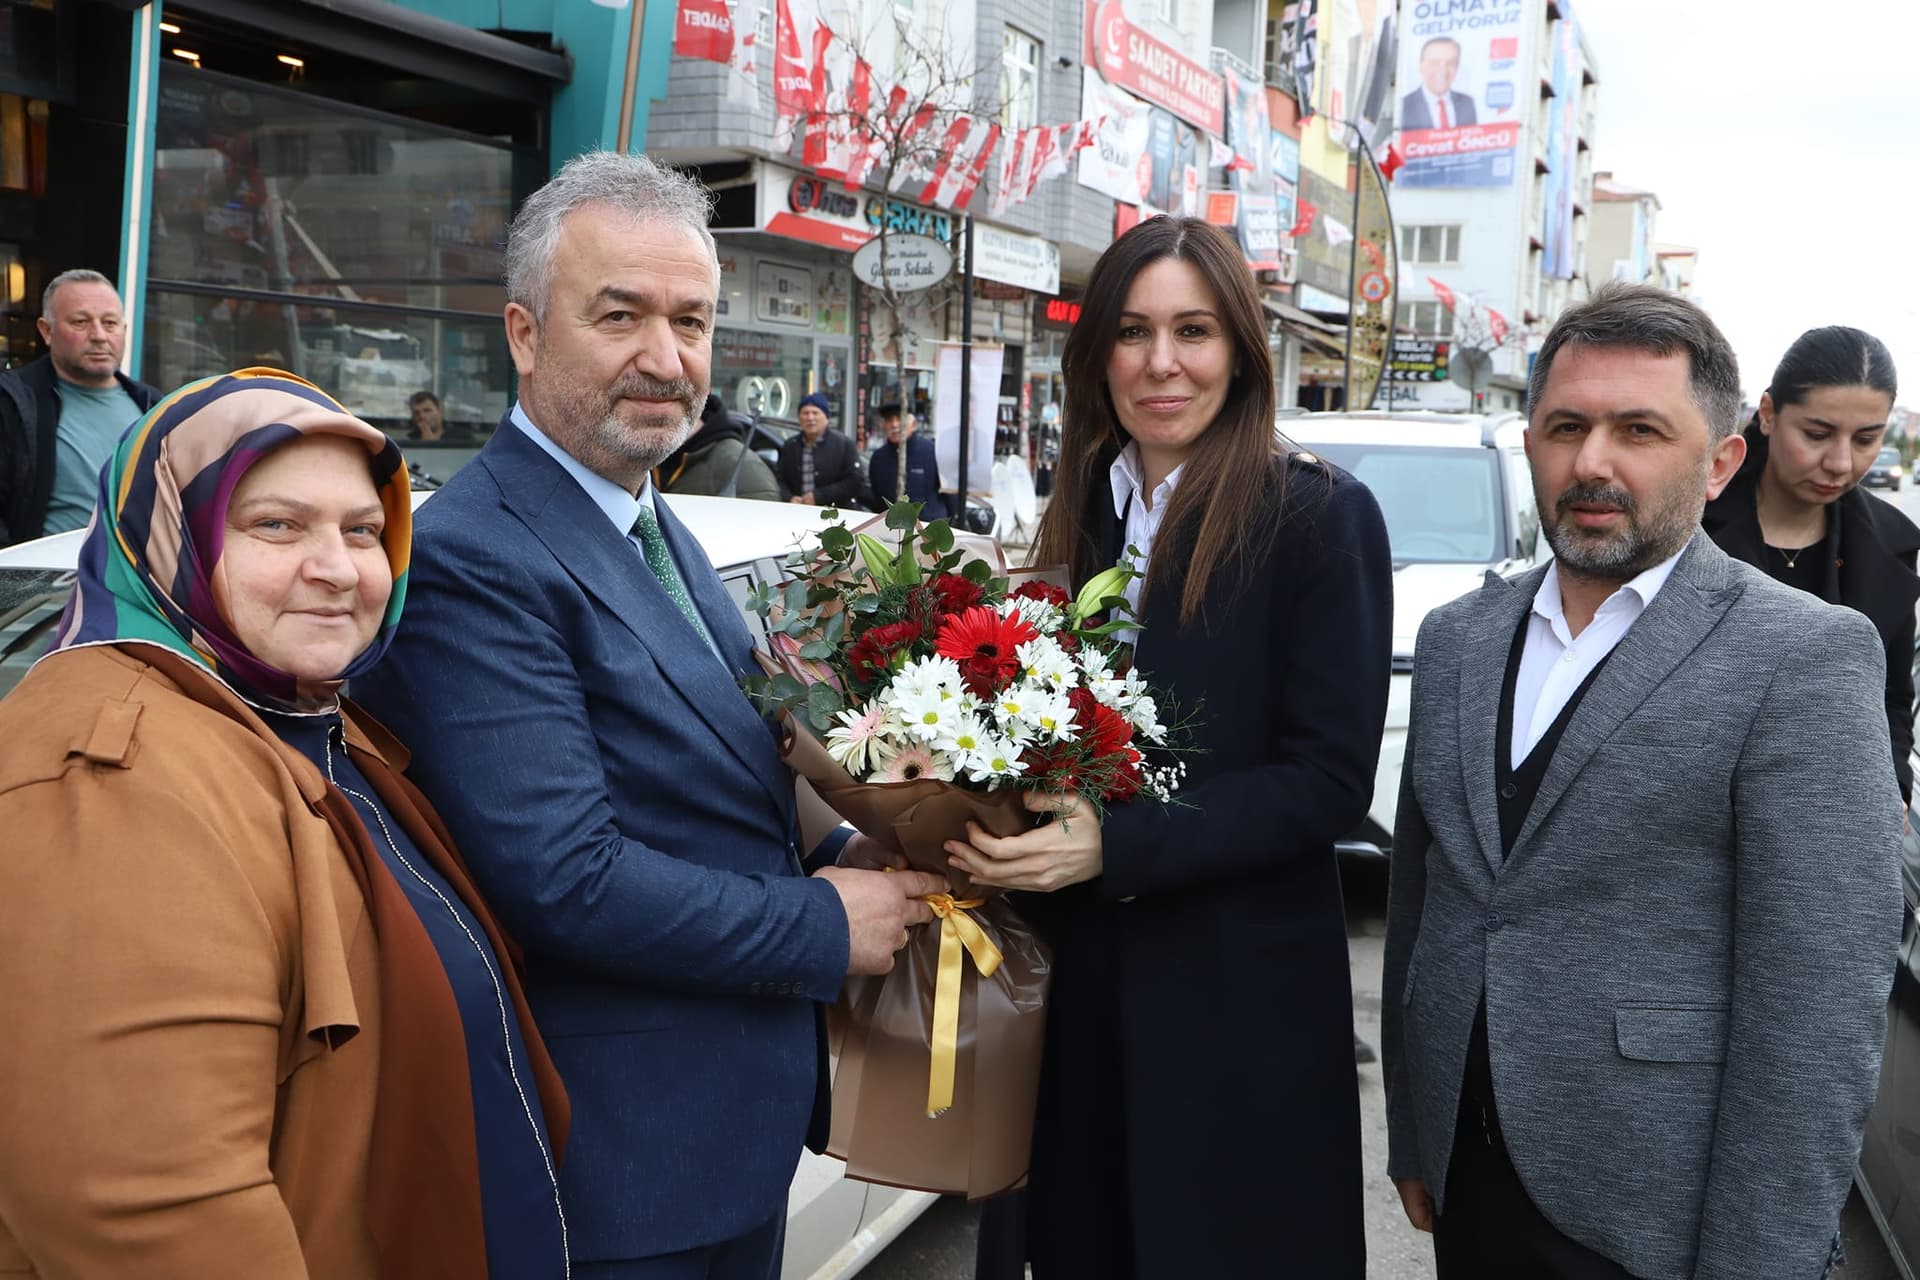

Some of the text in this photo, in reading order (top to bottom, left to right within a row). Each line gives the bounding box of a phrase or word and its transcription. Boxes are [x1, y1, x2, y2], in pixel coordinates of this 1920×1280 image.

[1128, 33, 1178, 85] SAADET
[1406, 141, 1454, 156] Cevat
[1457, 130, 1511, 150] ÖNCÜ
[904, 260, 935, 277] Sokak
[1375, 386, 1421, 402] EGAL
